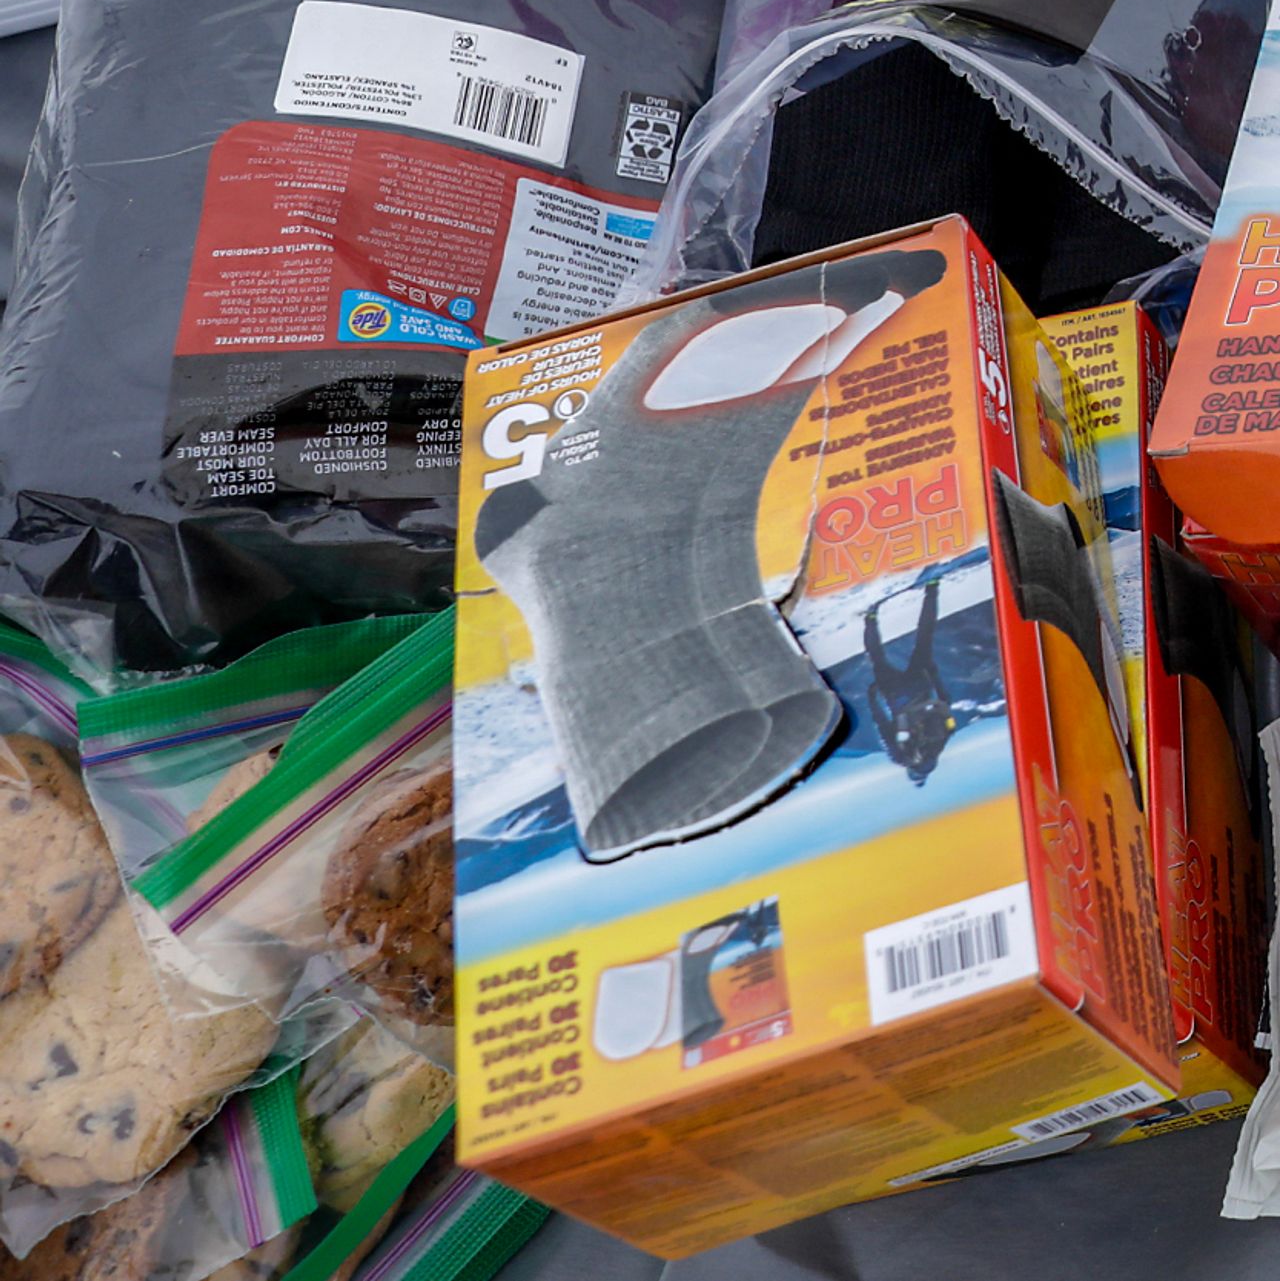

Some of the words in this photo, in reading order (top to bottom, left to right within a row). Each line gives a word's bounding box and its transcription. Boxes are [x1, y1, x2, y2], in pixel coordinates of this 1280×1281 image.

[631, 104, 678, 119] PLASTIC
[533, 208, 598, 235] Responsible.
[536, 200, 599, 225] Sustainable.
[517, 270, 566, 290] reducing
[537, 287, 597, 307] decreasing
[352, 310, 388, 329] Tide
[525, 313, 560, 328] Hanes
[400, 323, 435, 336] COLD
[1049, 325, 1119, 347] ontains
[214, 335, 276, 345] GUARANTEE
[551, 332, 603, 354] HORAS
[912, 330, 947, 350] DEL
[530, 347, 552, 361] DE
[532, 345, 602, 371] CHALEUR
[882, 341, 911, 360] PIE
[902, 344, 949, 368] PARA
[1072, 342, 1115, 360] Pairs
[477, 353, 528, 374] CALOR
[543, 356, 602, 377] HEURES
[521, 374, 544, 386] DE
[550, 368, 602, 389] HOURS
[485, 389, 527, 409] HEAT
[528, 384, 549, 397] OF
[808, 373, 951, 422] CALENTADORES
[237, 427, 275, 440] SEAM
[325, 421, 388, 435] COMFORT
[1195, 412, 1239, 436] DE
[200, 429, 234, 443] EVER
[304, 436, 331, 449] DAY
[334, 435, 359, 447] ALL
[362, 434, 387, 446] FOR
[562, 429, 600, 447] HASTA
[177, 440, 275, 459] COMFORTABLE
[299, 448, 387, 462] FOOTBOTTOM
[482, 403, 550, 490] 5
[197, 458, 234, 471] MOST
[237, 455, 266, 467] OUR
[314, 460, 388, 474] CUSHIONED
[207, 471, 245, 484] SEAM
[249, 468, 275, 480] TOE
[827, 468, 864, 490] TOE
[211, 481, 275, 497] COMFORT
[814, 464, 960, 544] PRO
[811, 510, 966, 591] HEAT
[477, 974, 579, 1016] Contiene
[482, 1024, 580, 1068] Contient
[481, 1076, 583, 1119] Contains
